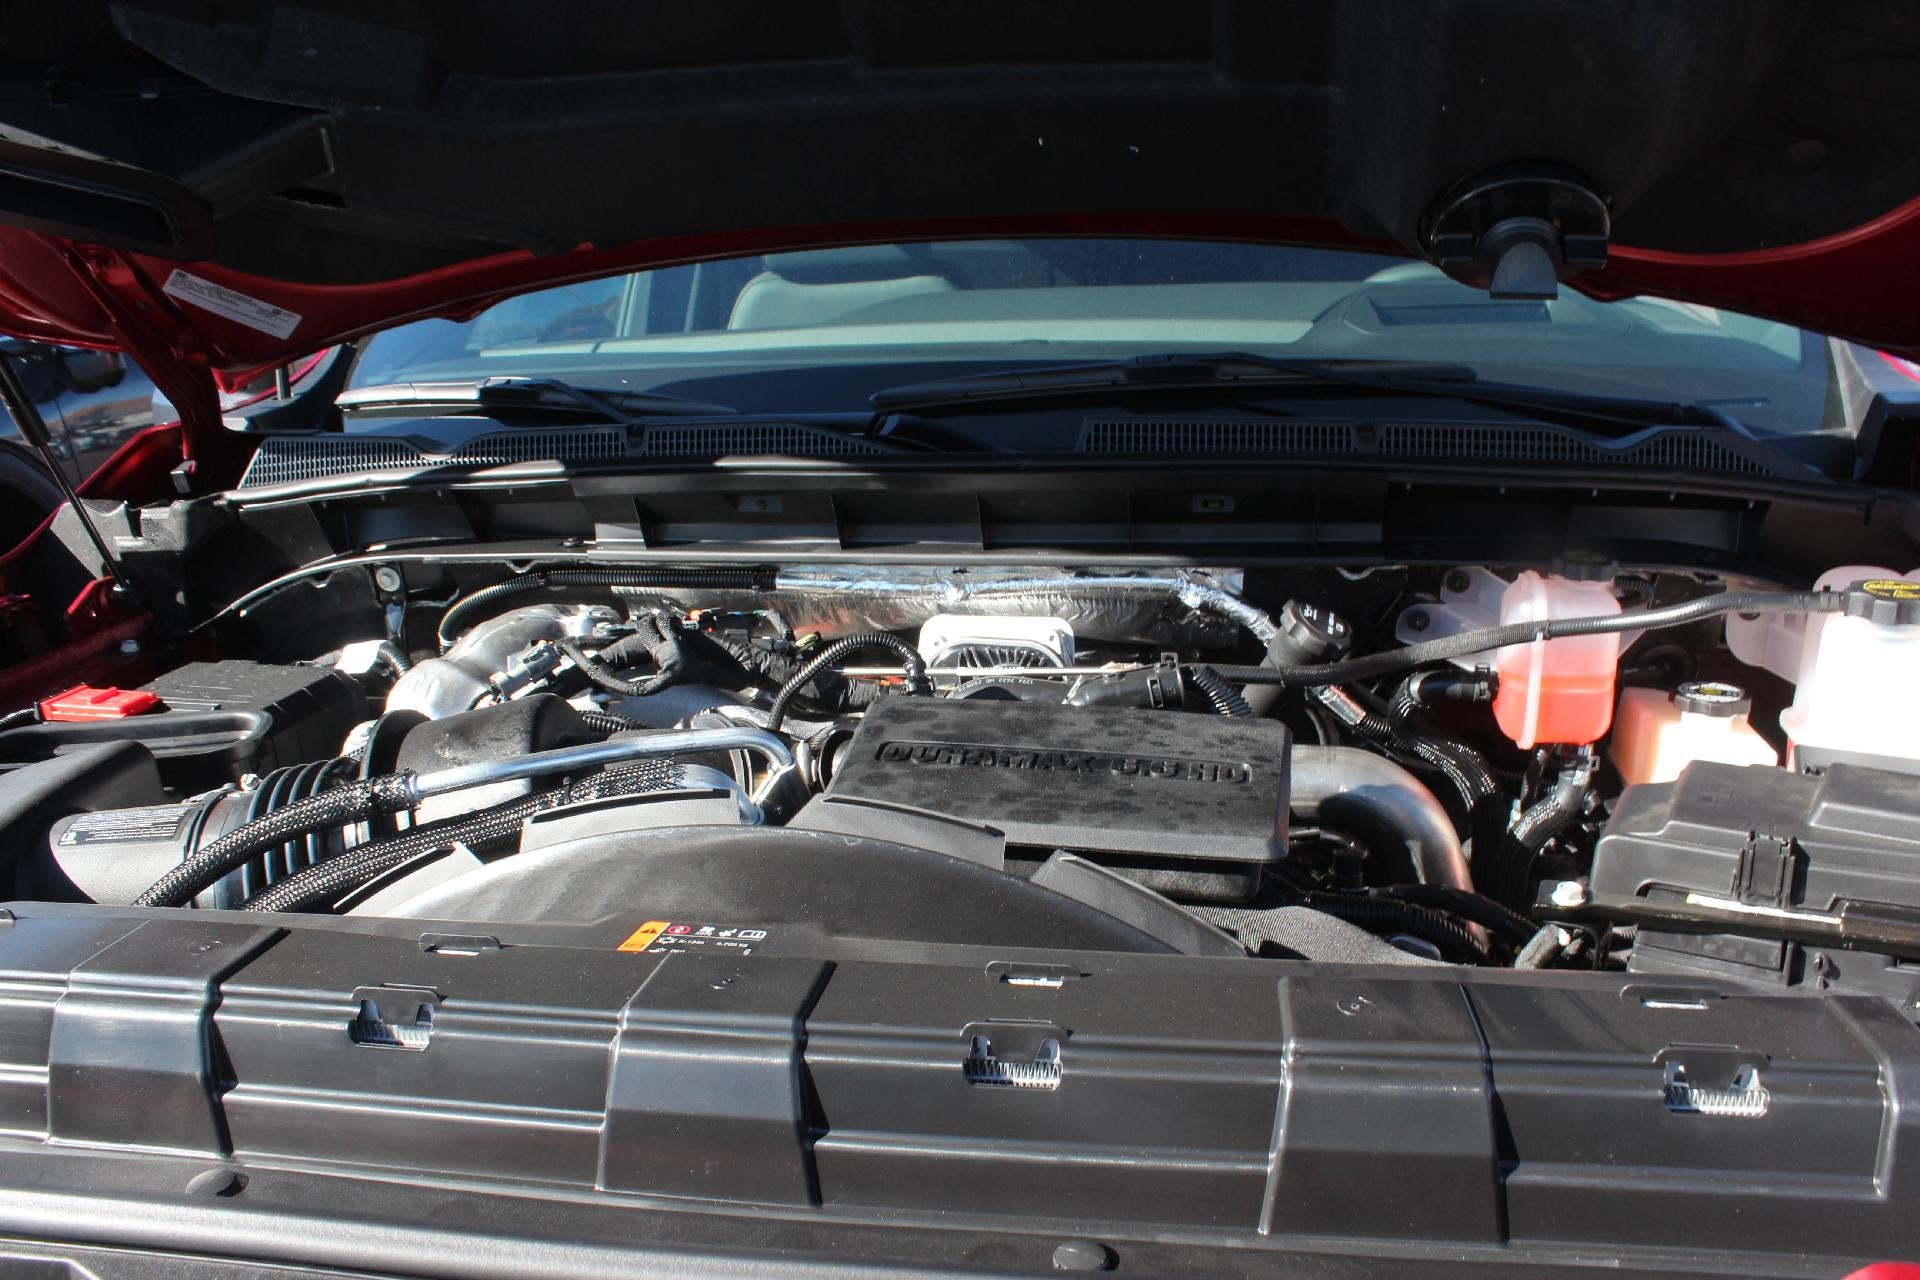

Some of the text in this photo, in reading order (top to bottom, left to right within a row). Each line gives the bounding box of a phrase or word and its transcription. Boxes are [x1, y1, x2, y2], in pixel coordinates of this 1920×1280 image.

[881, 741, 1250, 784] DURAMAX 6.6 HD
